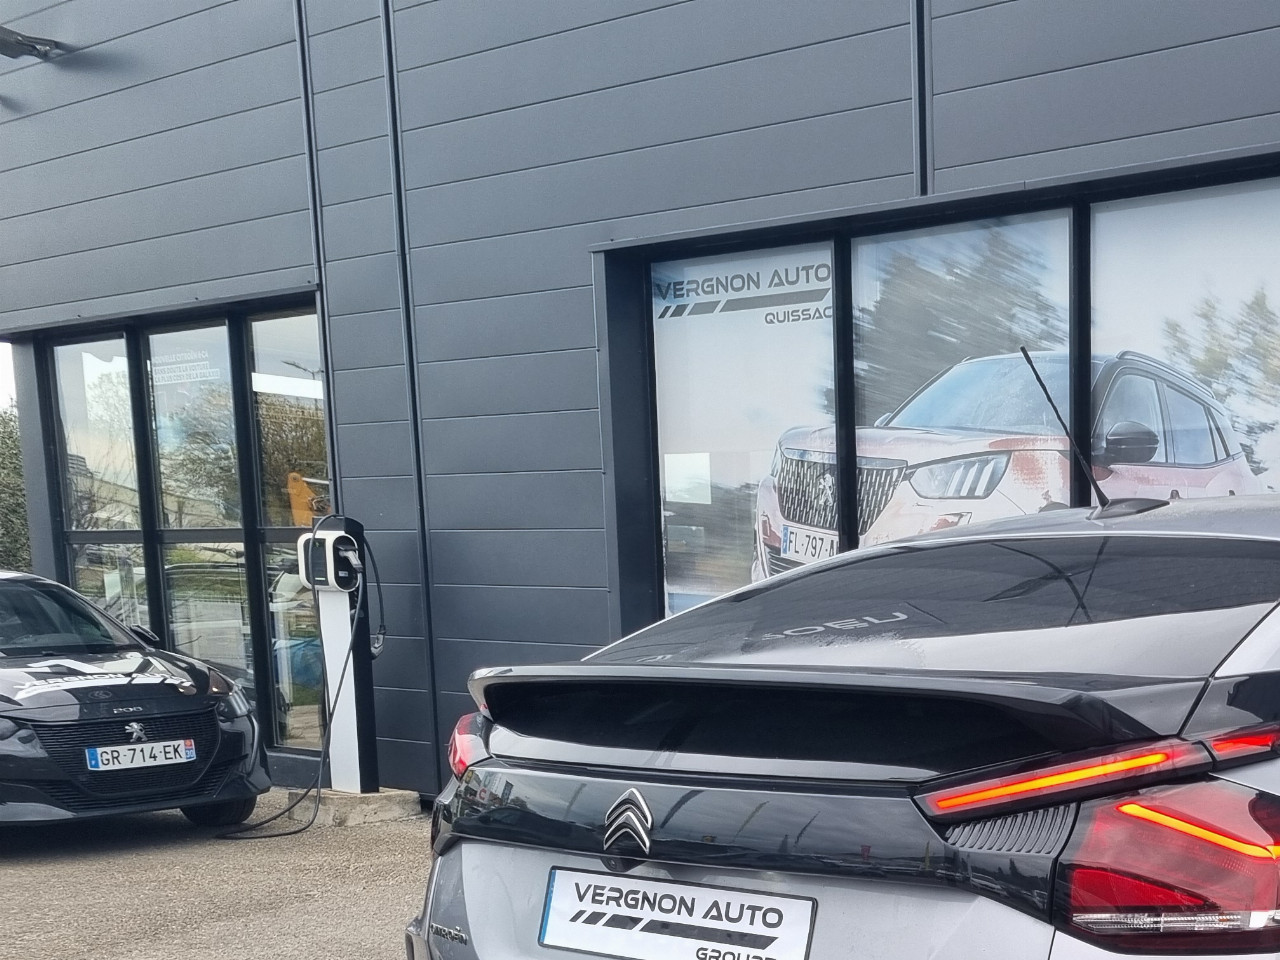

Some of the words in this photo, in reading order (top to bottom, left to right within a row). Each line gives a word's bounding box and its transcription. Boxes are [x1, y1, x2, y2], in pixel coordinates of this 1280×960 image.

[655, 271, 761, 301] VERGNON
[767, 263, 831, 289] AUTO
[764, 305, 833, 325] QUISSAC
[575, 881, 696, 919] VERGNON
[702, 898, 785, 930] AUTO
